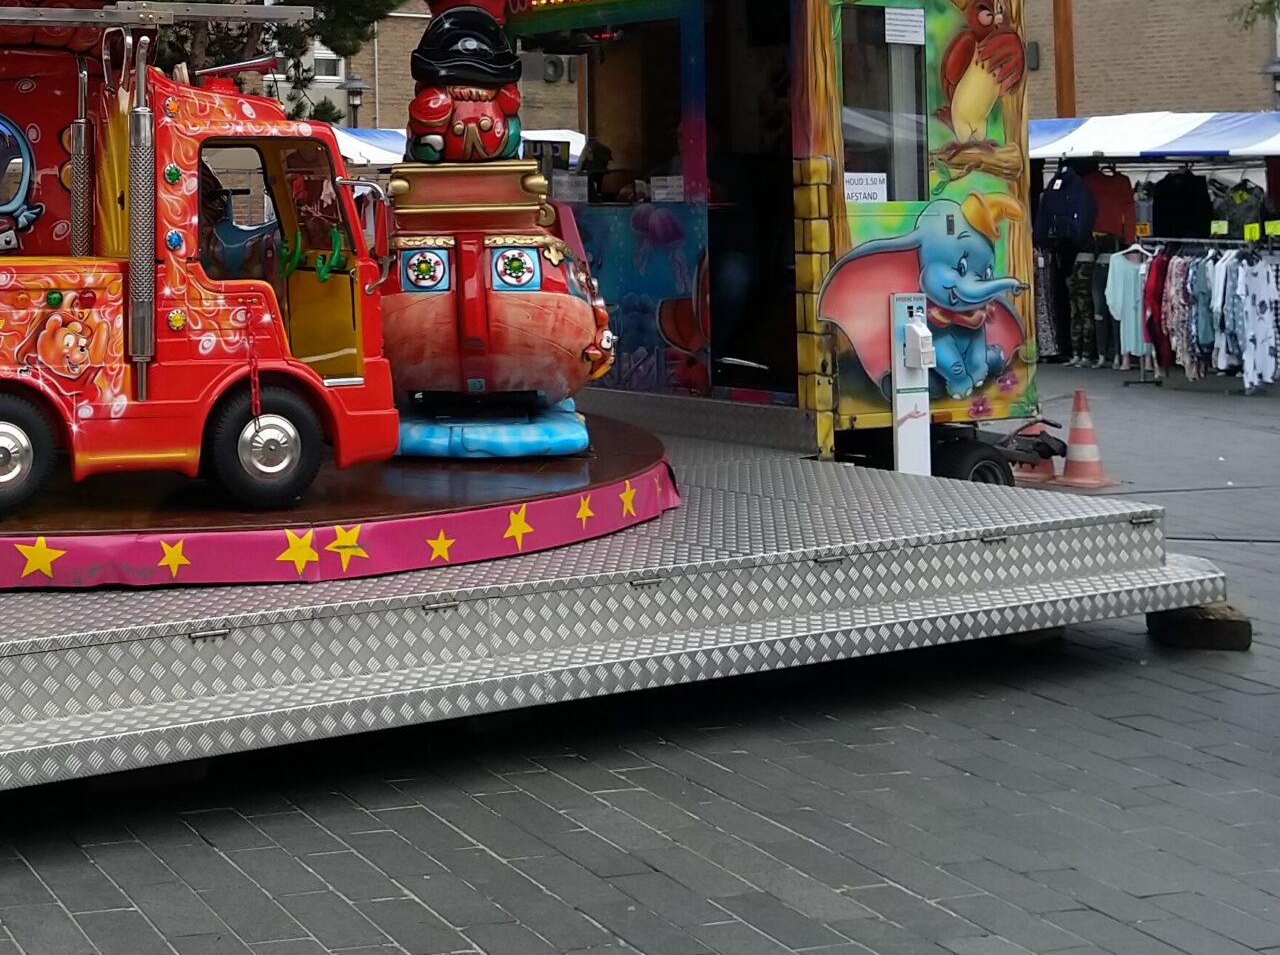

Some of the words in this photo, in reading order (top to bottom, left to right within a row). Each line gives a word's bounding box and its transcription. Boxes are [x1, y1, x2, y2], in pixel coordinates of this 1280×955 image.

[846, 177, 864, 186] HOUD
[878, 177, 886, 185] M
[846, 191, 879, 201] AFSTAND
